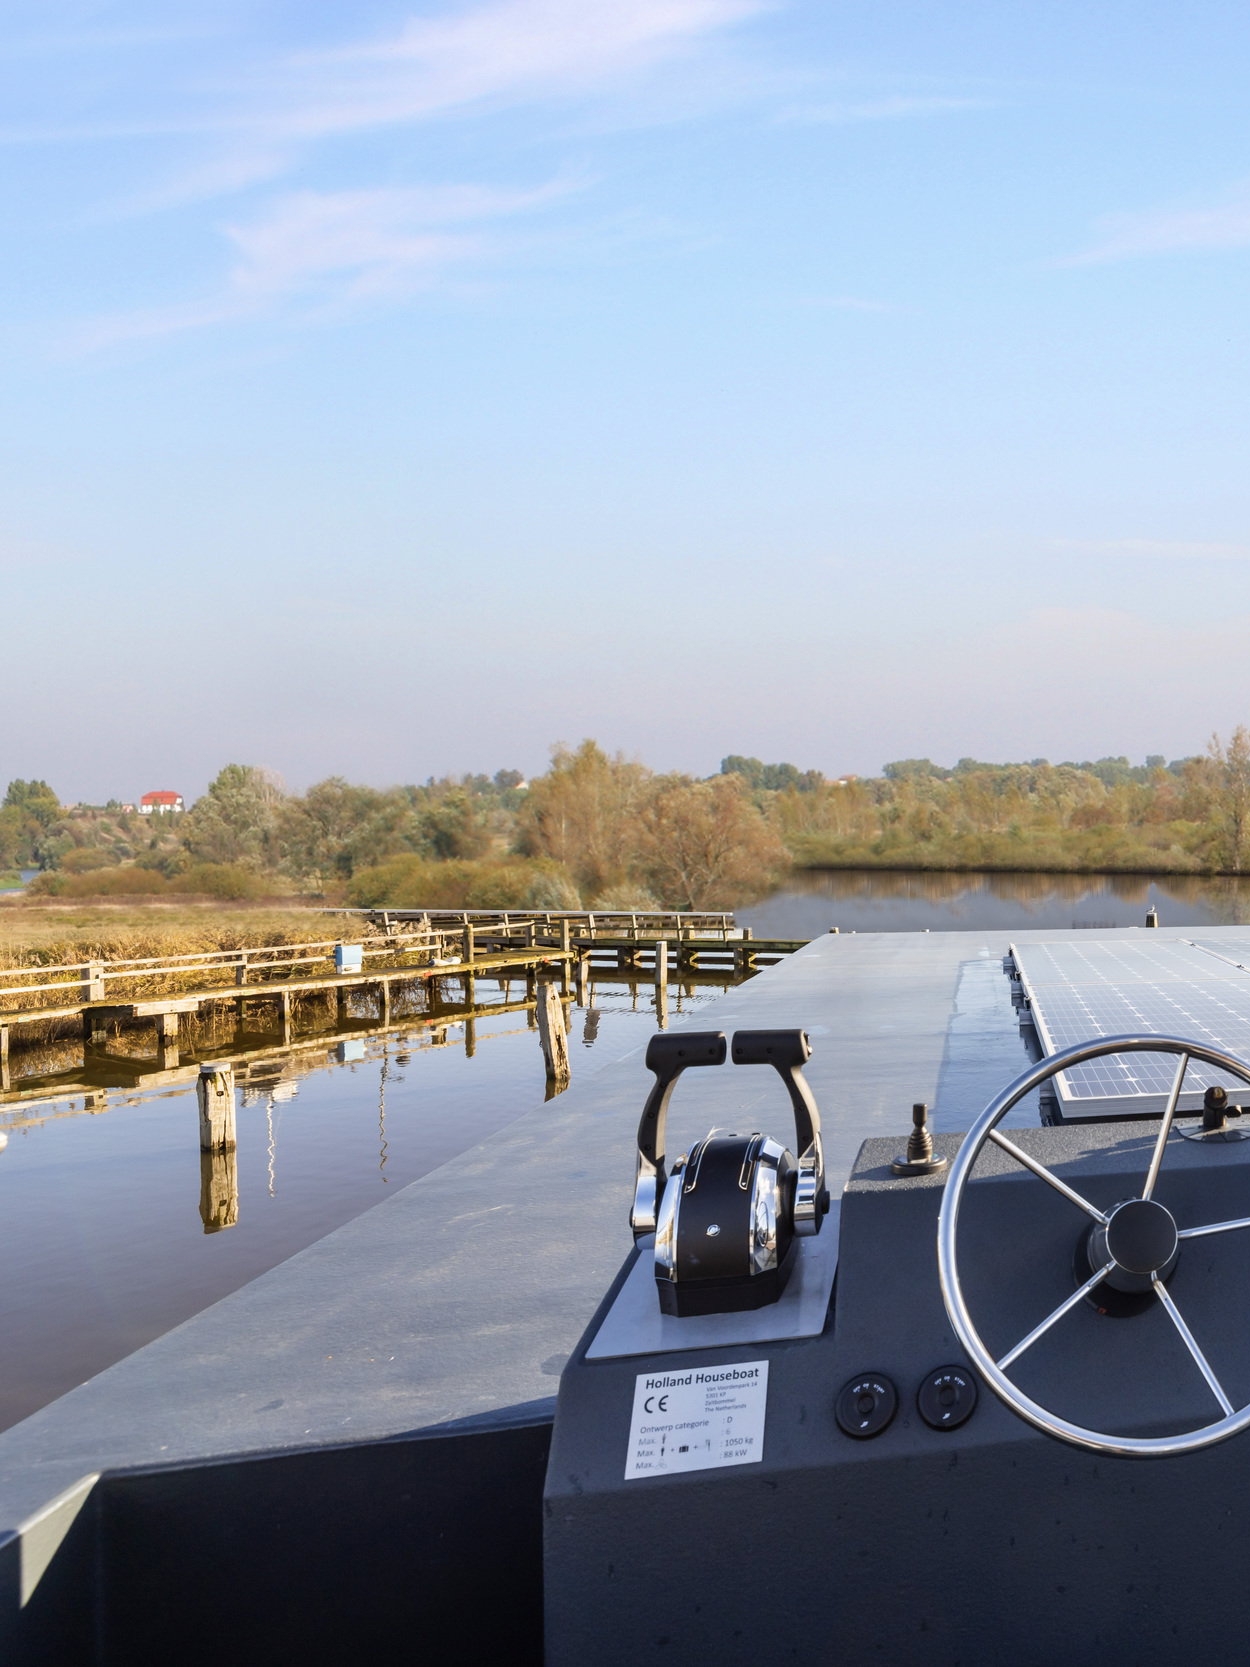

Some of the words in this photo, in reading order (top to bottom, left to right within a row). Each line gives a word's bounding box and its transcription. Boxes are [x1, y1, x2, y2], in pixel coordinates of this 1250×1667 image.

[645, 1374, 692, 1389] Holland
[695, 1368, 760, 1384] Houseboat
[715, 1403, 747, 1412] Netherlands
[640, 1424, 674, 1434] Ontwerp
[674, 1420, 710, 1430] categorie
[726, 1416, 733, 1424] D
[637, 1450, 656, 1458] Max.
[725, 1437, 744, 1447] 1050
[744, 1436, 754, 1445] kg
[638, 1438, 657, 1446] Max.
[635, 1462, 655, 1470] Max.
[734, 1448, 748, 1457] kW
